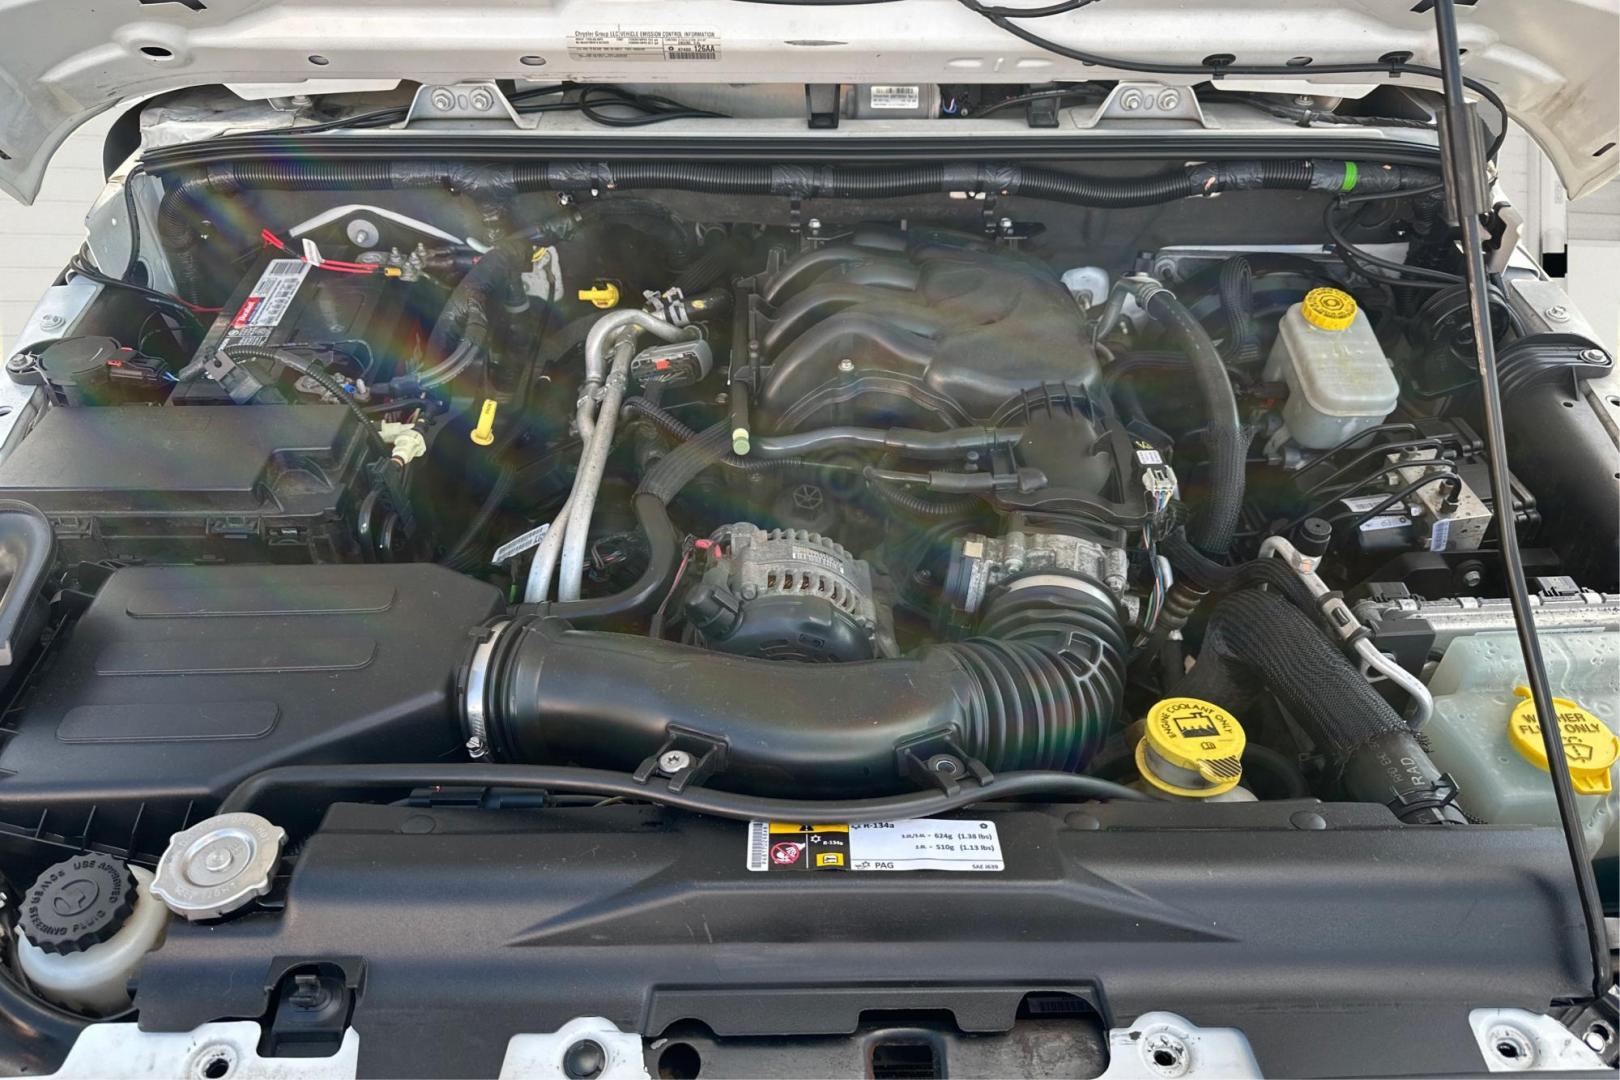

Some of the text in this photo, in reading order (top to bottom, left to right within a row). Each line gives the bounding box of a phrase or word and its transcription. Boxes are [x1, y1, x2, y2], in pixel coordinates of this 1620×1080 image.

[1160, 703, 1233, 739] ENGINE COOLANT ONLY
[1521, 712, 1586, 724] WHER
[1564, 723, 1600, 733] ONLY
[1400, 757, 1425, 786] RAD
[980, 844, 995, 852] lbs)
[73, 860, 122, 904] USE APPROVED
[29, 906, 68, 936] STEERING
